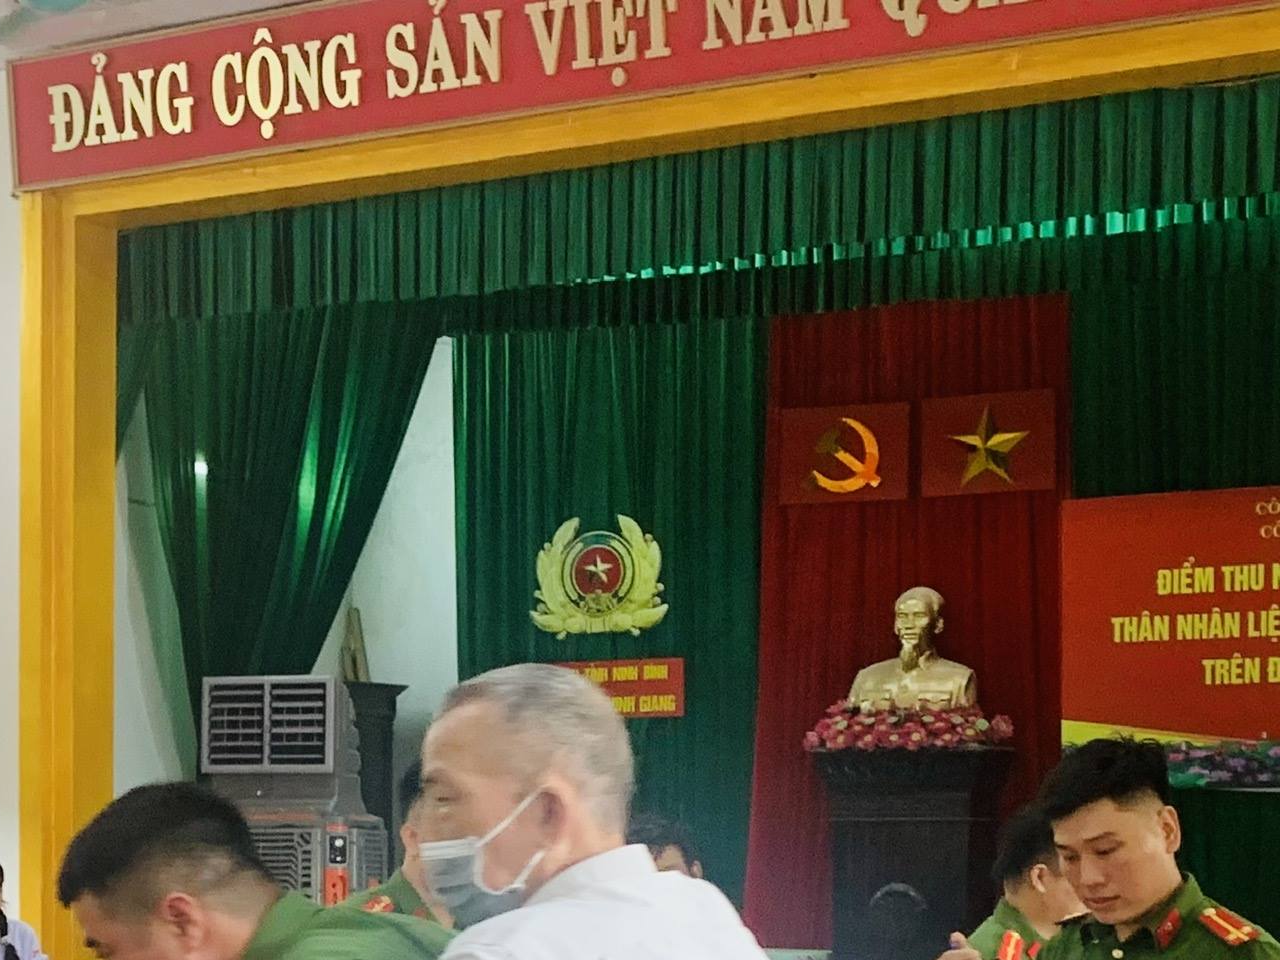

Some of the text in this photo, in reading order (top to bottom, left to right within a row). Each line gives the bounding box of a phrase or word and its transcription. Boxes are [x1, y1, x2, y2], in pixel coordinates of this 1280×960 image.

[48, 52, 194, 153] ĐẢNG
[211, 27, 362, 140] CỘNG
[385, 0, 504, 99] SẢN
[1156, 556, 1215, 596] ĐIỂM
[1222, 564, 1265, 592] THU
[1111, 610, 1170, 643] THÂN
[1176, 607, 1240, 640] NHÂN
[1202, 653, 1260, 685] TRÊN
